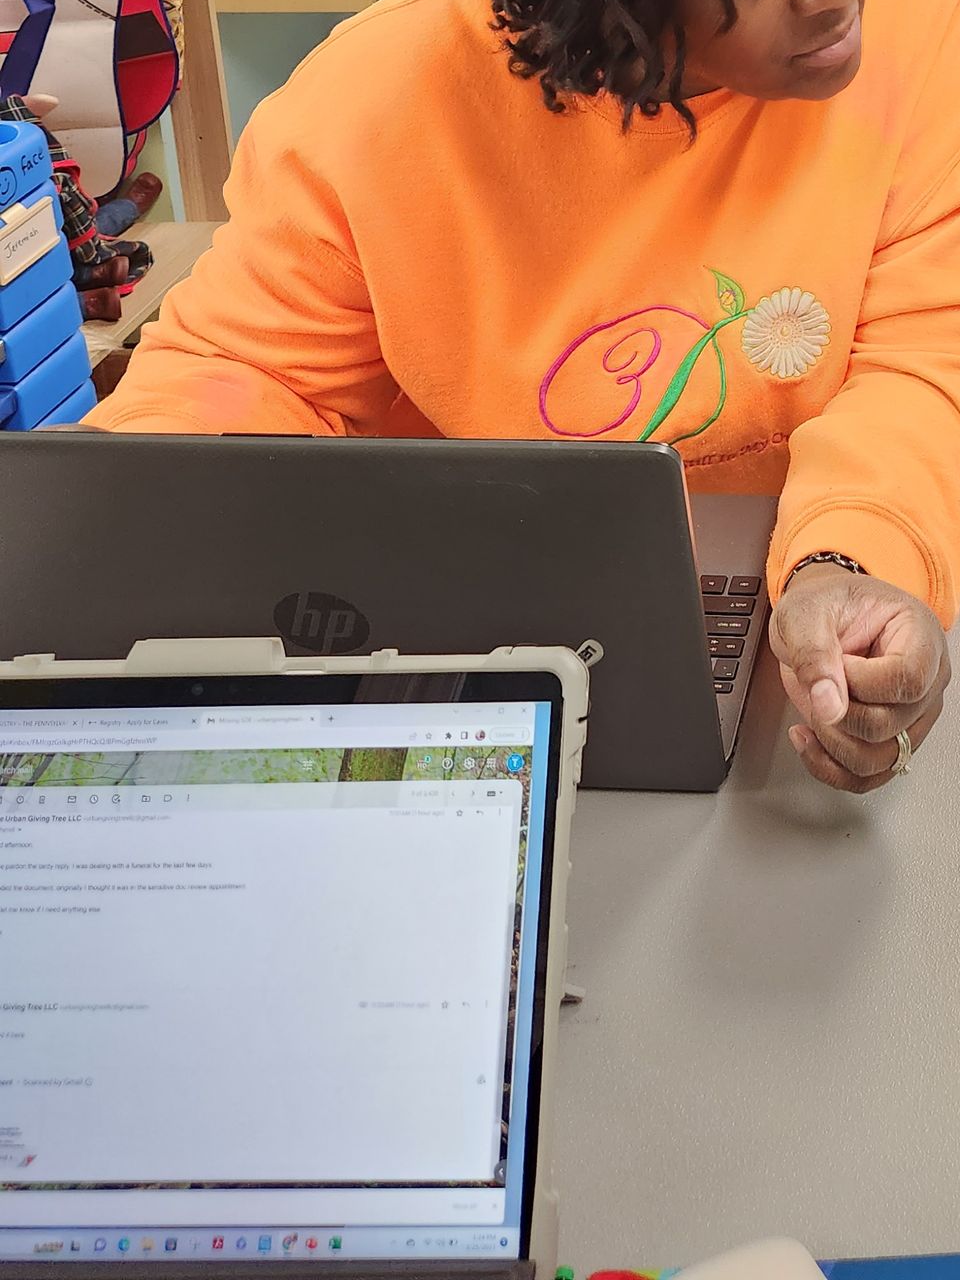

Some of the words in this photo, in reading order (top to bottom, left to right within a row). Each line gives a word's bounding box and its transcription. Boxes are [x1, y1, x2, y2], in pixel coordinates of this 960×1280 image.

[4, 228, 39, 259] Jeremiah
[294, 593, 357, 644] hp
[28, 815, 50, 823] Giving
[88, 884, 111, 892] thought
[2, 1003, 25, 1012] Giving
[43, 1003, 59, 1011] LLC
